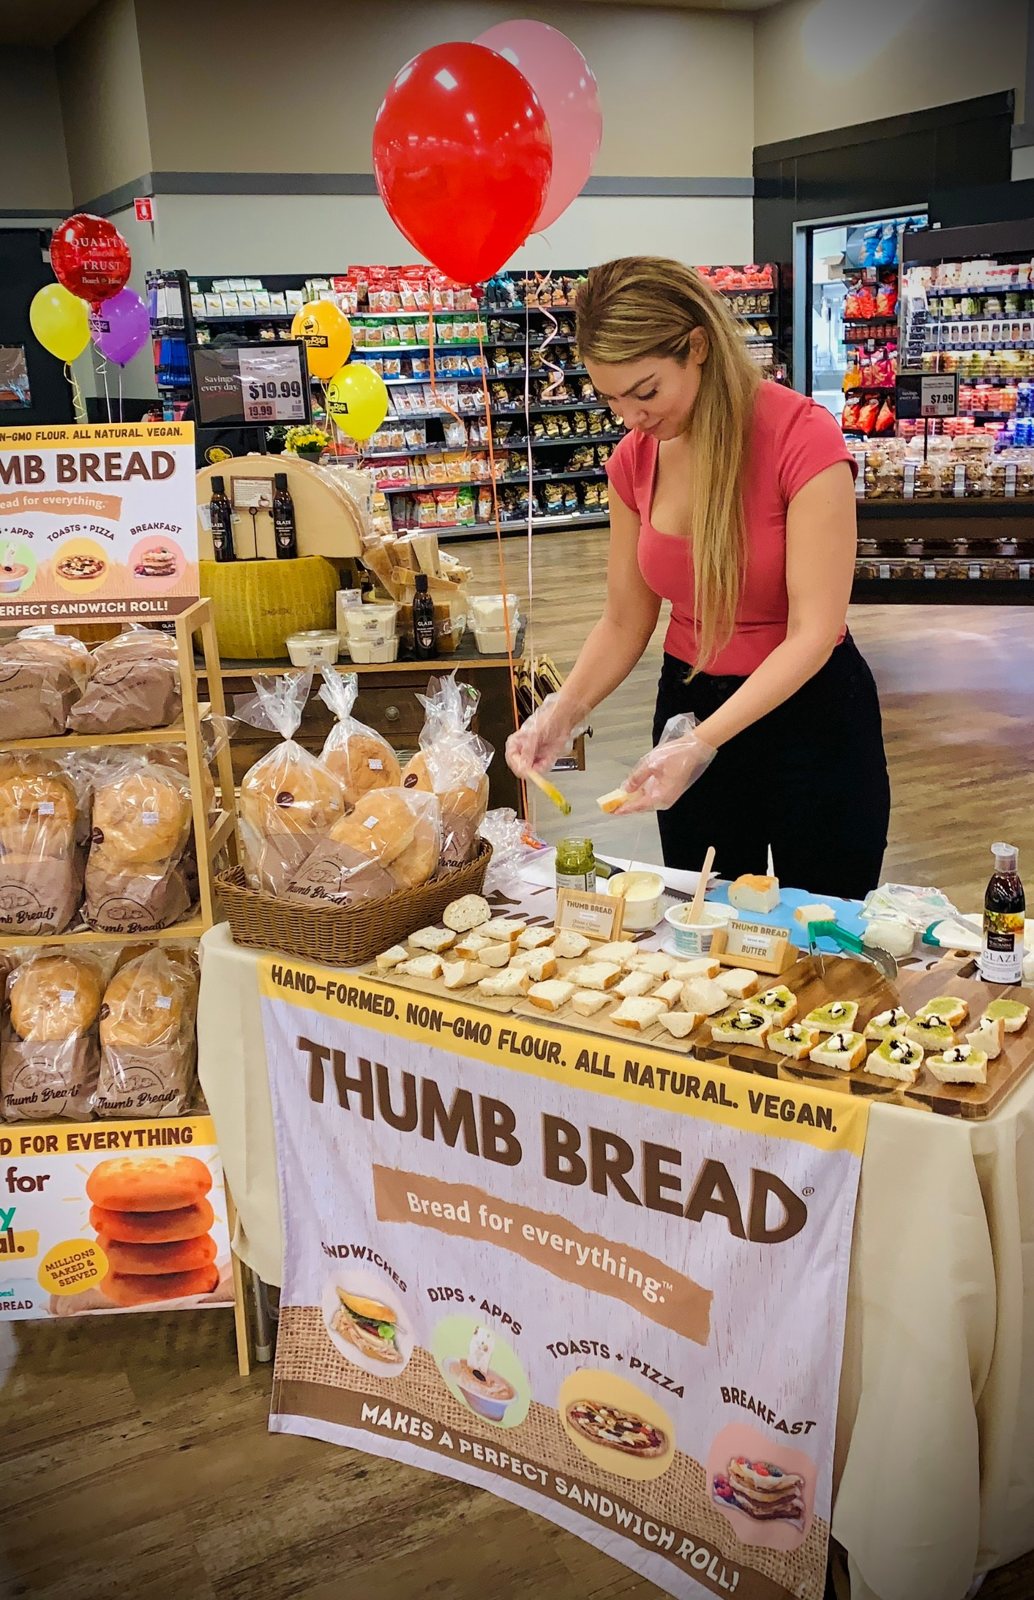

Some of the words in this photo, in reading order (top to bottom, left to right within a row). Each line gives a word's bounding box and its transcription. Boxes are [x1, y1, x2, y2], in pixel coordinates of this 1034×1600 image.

[83, 261, 120, 270] TRUST
[204, 375, 234, 383] Savings
[224, 383, 238, 392] day.
[248, 381, 300, 400] $19.99
[930, 394, 954, 404] $7.99
[248, 406, 272, 416] 19.99
[36, 430, 69, 440] FLOUR.
[72, 430, 91, 439] ALL
[94, 428, 143, 438] NATURAL.
[147, 426, 183, 437] VEGAN.
[56, 450, 176, 483] BREAD
[23, 496, 39, 506] for
[42, 495, 106, 510] everything.
[10, 527, 34, 538] APPS
[47, 524, 80, 542] TOASTS
[90, 525, 115, 541] PIZZA
[130, 522, 182, 536] BREAKFAST
[50, 602, 126, 614] SANDWICH
[130, 600, 168, 612] ROLL!
[566, 900, 588, 910] THUMB
[590, 905, 612, 914] BREAD
[732, 922, 758, 932] THUMB
[760, 928, 788, 938] BREAD
[742, 945, 767, 956] BUTTER
[982, 951, 1018, 962] GLAZE
[271, 964, 400, 1020] HAND-FORMED.
[406, 1003, 492, 1046] NON-GMO
[498, 1028, 566, 1067] FLOUR.
[574, 1048, 616, 1079] ALL
[623, 1060, 738, 1108] NATURAL.
[748, 1090, 838, 1132] VEGAN.
[5, 1094, 38, 1107] Thumb
[41, 1085, 79, 1101] Bread
[97, 1096, 134, 1109] Thumb
[136, 1088, 176, 1108] Bread
[20, 1134, 58, 1154] FOR
[66, 1126, 194, 1152] EVERYTHING
[297, 1035, 523, 1166] THUMB
[542, 1112, 808, 1244] BREAD
[6, 1166, 50, 1194] for
[406, 1190, 472, 1225] Bread
[478, 1204, 514, 1235] for
[522, 1220, 666, 1304] everything.
[45, 1248, 96, 1272] MILLIONS
[321, 1242, 408, 1292] NDWICHES
[52, 1263, 86, 1280] BAKED
[58, 1268, 98, 1288] SERVED
[427, 1286, 464, 1302] DIPS
[480, 1299, 522, 1336] APPS
[546, 1338, 610, 1360] TOASTS
[629, 1355, 685, 1399] PIZZA
[719, 1385, 817, 1436] BREAKFAST
[360, 1400, 434, 1442] MAKES
[438, 1432, 454, 1450] A
[458, 1438, 550, 1486] PERFECT
[554, 1475, 676, 1552] SANDWICH
[675, 1536, 742, 1593] ROLL!
